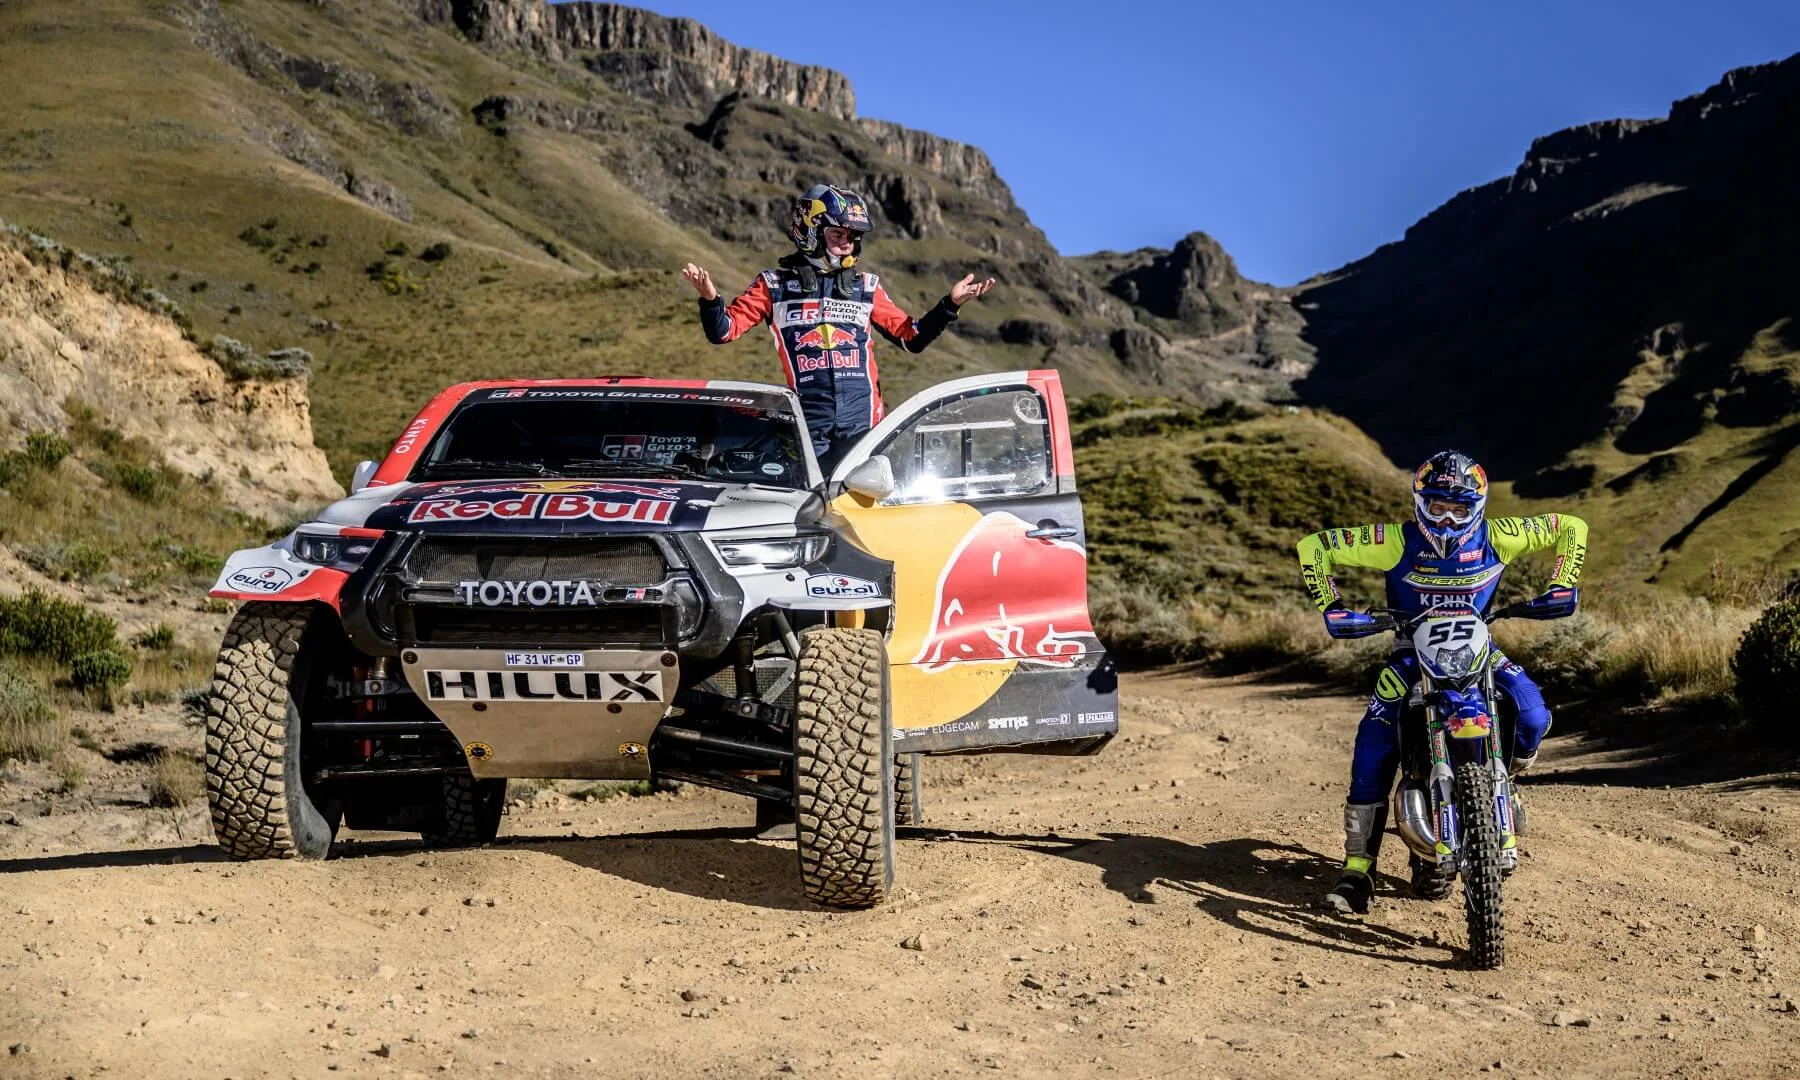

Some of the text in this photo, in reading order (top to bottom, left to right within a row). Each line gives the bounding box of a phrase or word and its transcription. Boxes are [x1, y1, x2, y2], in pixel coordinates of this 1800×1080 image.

[786, 309, 819, 321] GR
[823, 311, 856, 321] Racing
[797, 349, 860, 372] Red Bull
[607, 391, 680, 399] GAZOO
[682, 394, 754, 405] Racing
[395, 418, 429, 454] KINTO
[603, 444, 642, 459] GR
[407, 493, 676, 525] Red Bull
[233, 574, 285, 591] eurol
[1409, 571, 1489, 586] SHERCO
[459, 580, 597, 607] TOYOTA
[811, 584, 875, 595] eurol
[1420, 593, 1478, 608] KENNY
[1427, 620, 1477, 647] 55
[507, 654, 581, 665] HF 31 WF GP
[427, 671, 662, 702] HILUX
[932, 721, 980, 734] EDGECAM
